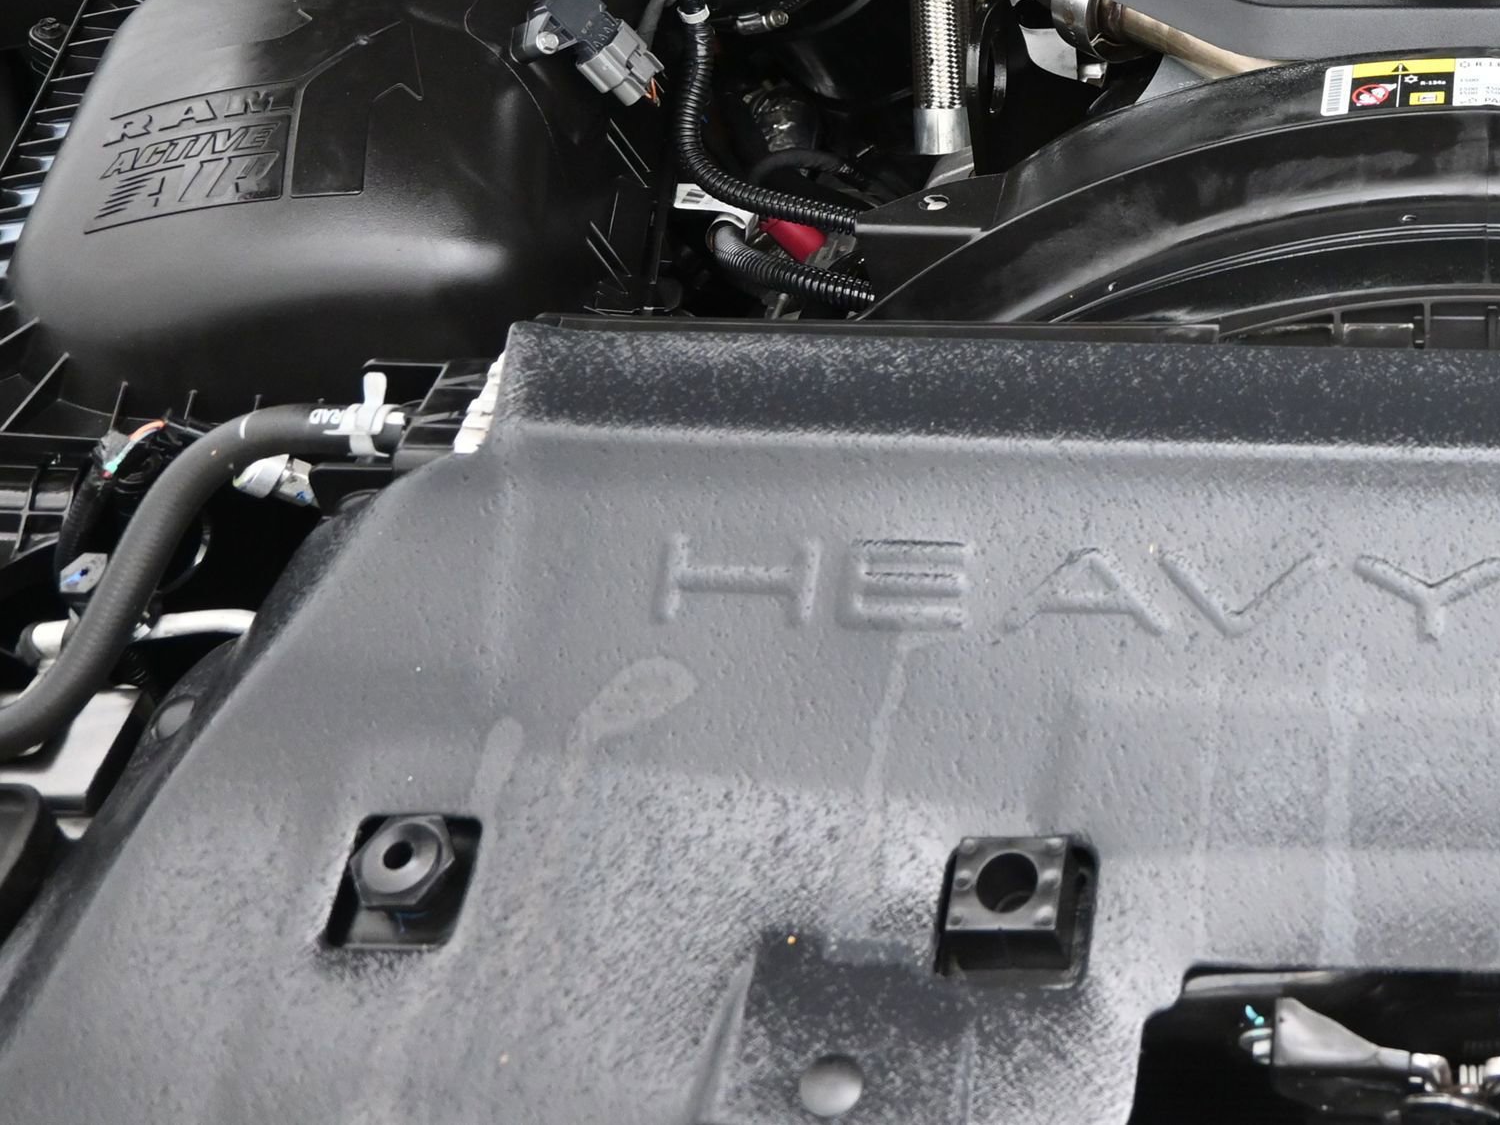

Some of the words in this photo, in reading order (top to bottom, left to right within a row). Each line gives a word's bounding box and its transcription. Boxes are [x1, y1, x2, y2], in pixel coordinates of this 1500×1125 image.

[102, 90, 292, 147] RAM
[99, 121, 281, 180] ACTIVE
[94, 151, 281, 220] AIR
